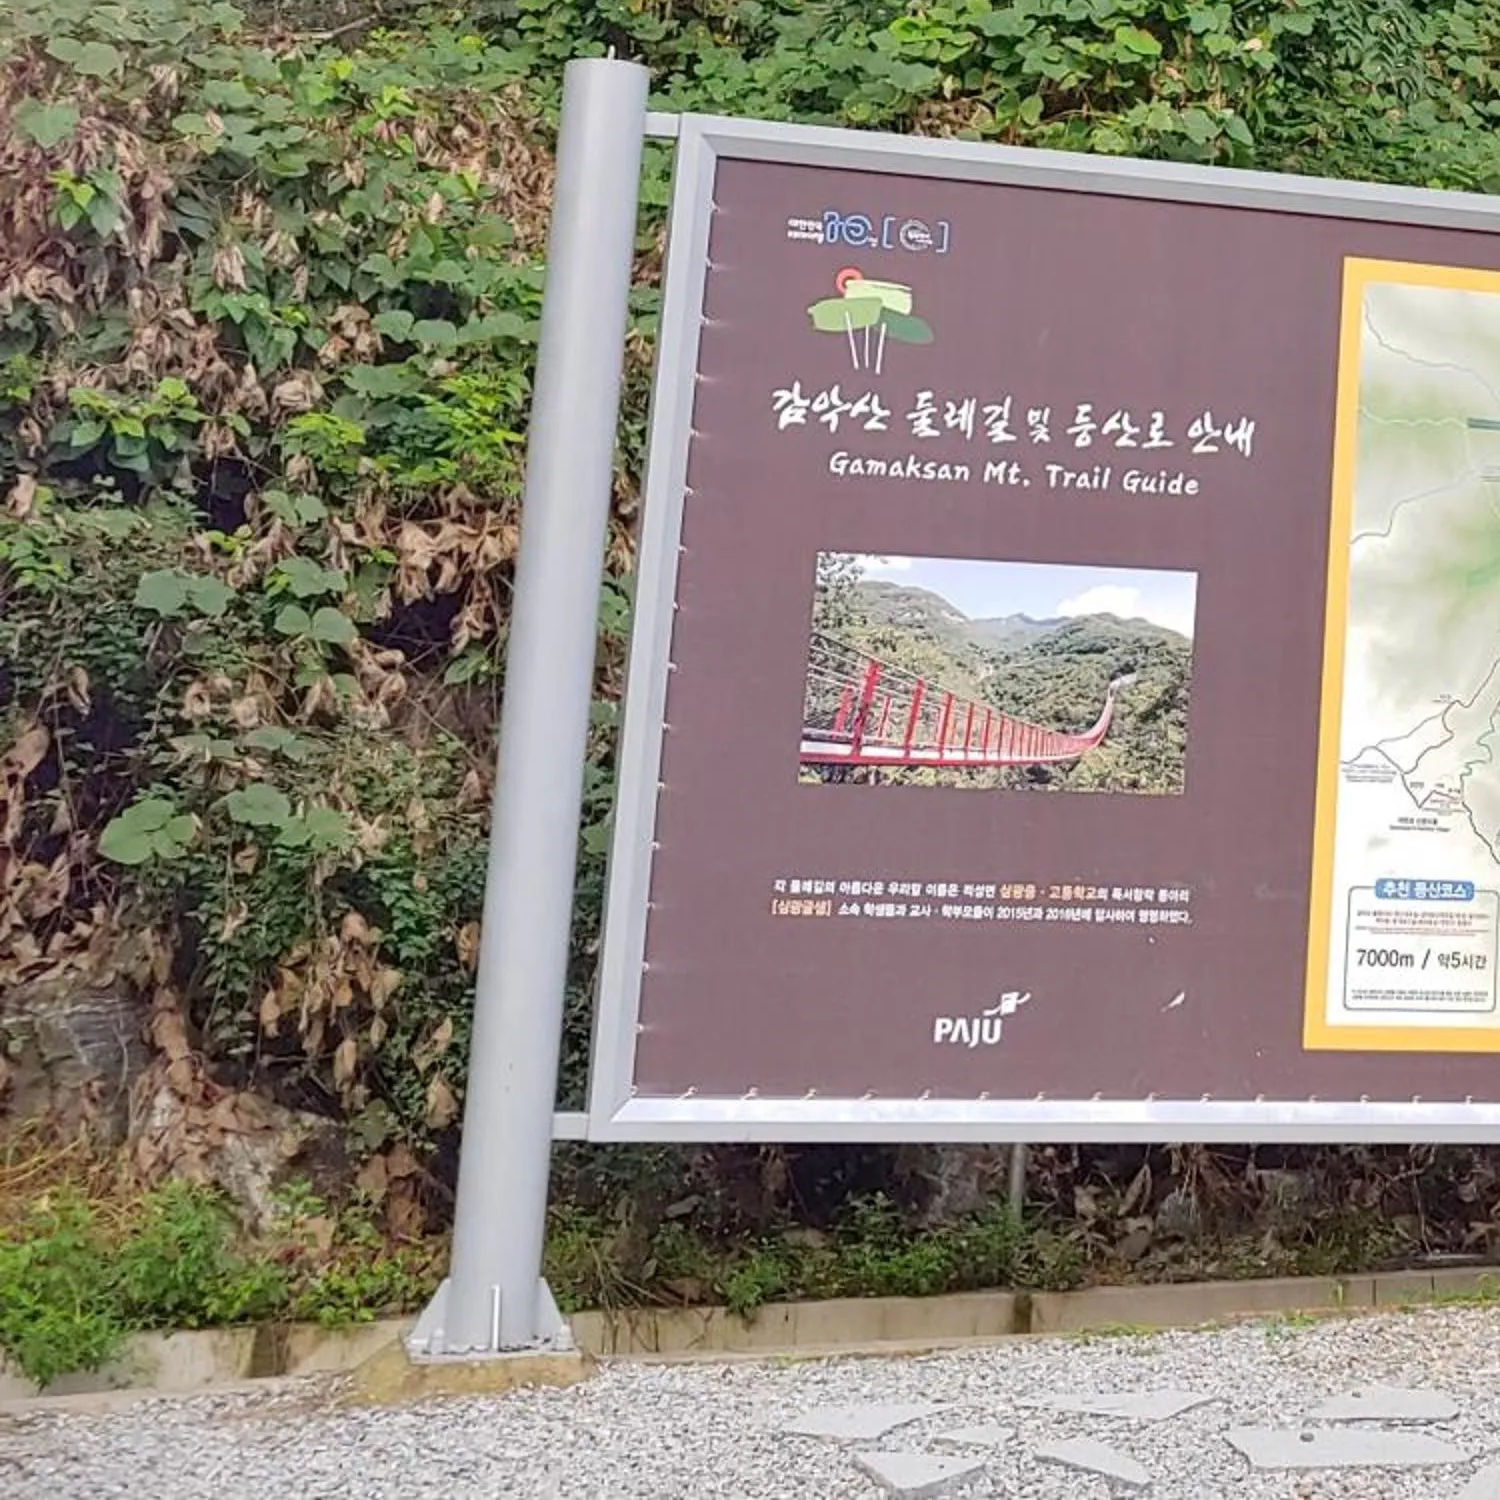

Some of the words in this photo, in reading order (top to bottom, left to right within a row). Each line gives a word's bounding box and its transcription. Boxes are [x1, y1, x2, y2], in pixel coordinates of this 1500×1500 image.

[772, 380, 891, 434] 감악산
[906, 390, 1017, 444] 둘레길
[1027, 407, 1051, 444] 및
[1066, 404, 1174, 449] 등산로
[1187, 411, 1256, 457] 안내
[829, 451, 970, 481] Gamaksan
[983, 460, 1030, 487] Mt.
[1045, 464, 1111, 490] Trail
[1122, 469, 1200, 496] Guide
[839, 880, 884, 896] 아름다운
[888, 882, 921, 897] 우리말
[925, 883, 960, 897] 이름은
[1158, 888, 1189, 903] 동아리
[1415, 881, 1467, 899] 등산코스
[1357, 949, 1414, 967] 7000m
[933, 1017, 1001, 1048] PAJU
